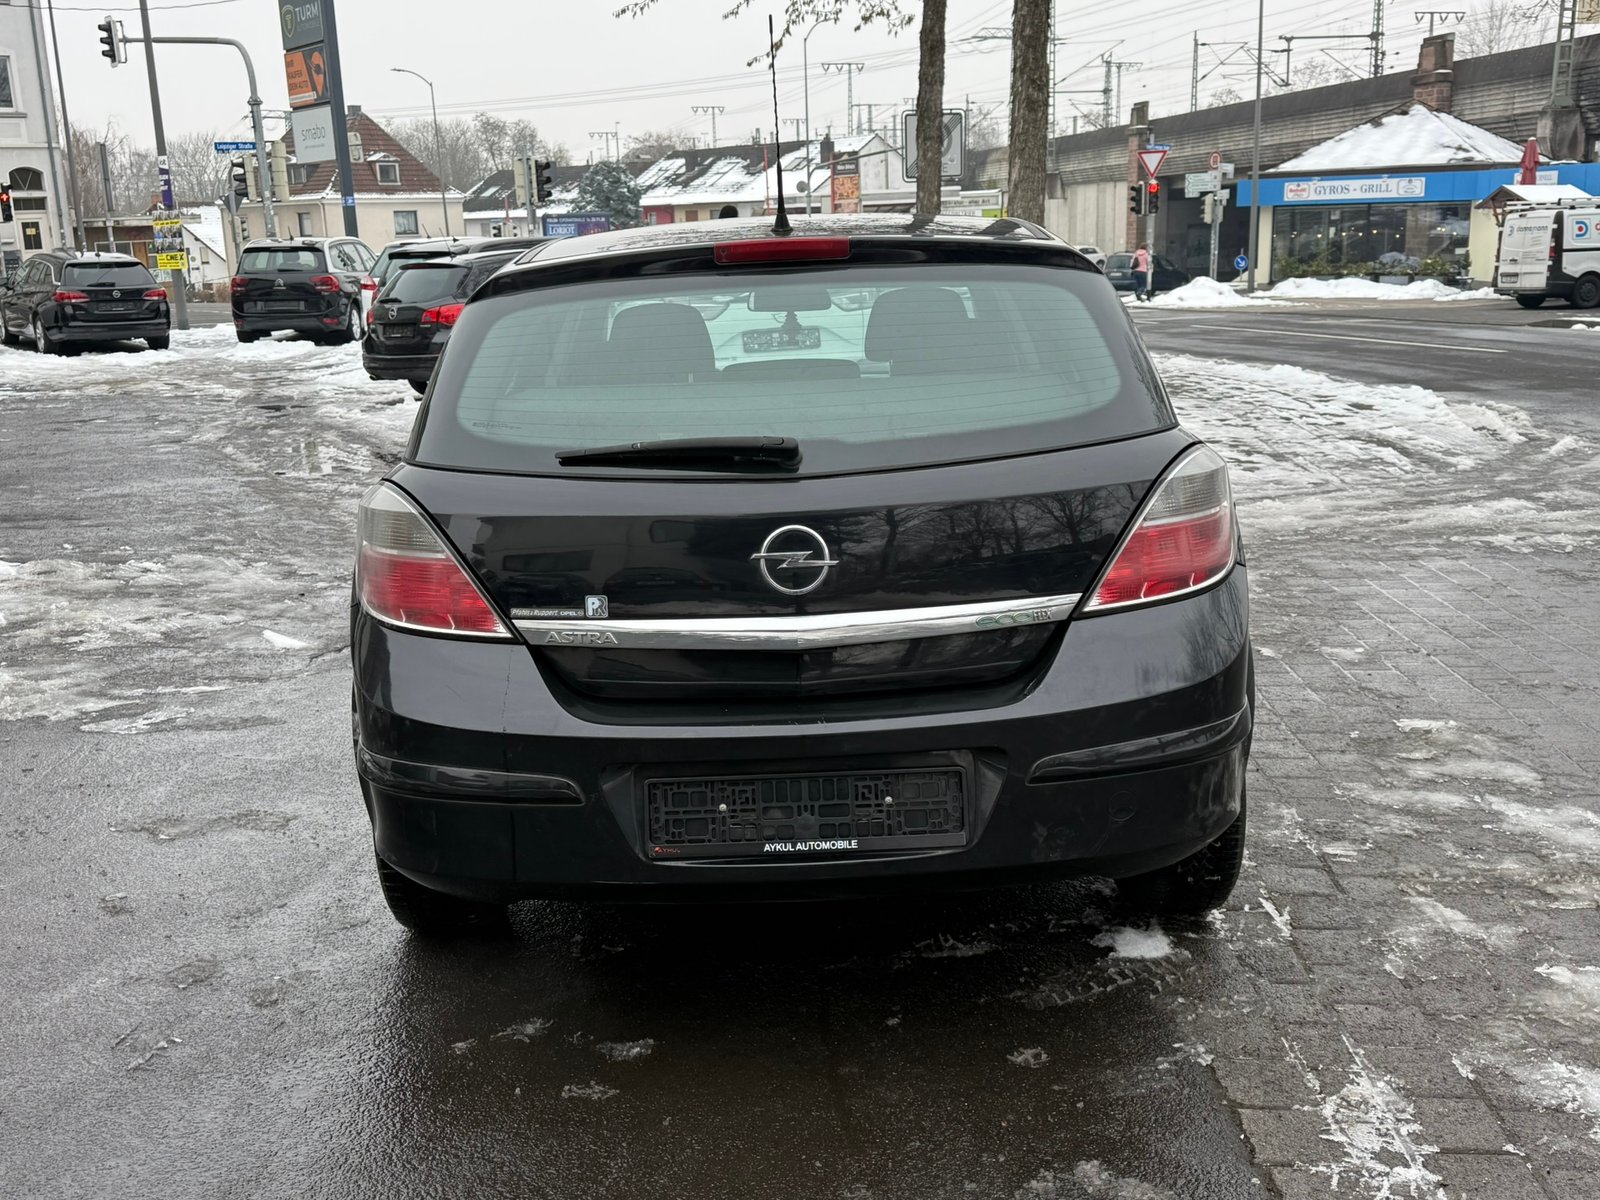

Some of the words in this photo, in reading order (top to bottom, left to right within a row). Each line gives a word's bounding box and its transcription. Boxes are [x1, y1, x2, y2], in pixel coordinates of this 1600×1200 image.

[295, 2, 318, 22] TURM
[1314, 184, 1350, 195] GYROS
[1360, 183, 1393, 194] GRILL
[545, 631, 619, 645] ASTRA
[763, 842, 794, 853] AYKUL
[796, 840, 859, 851] AUTOMOBILE
